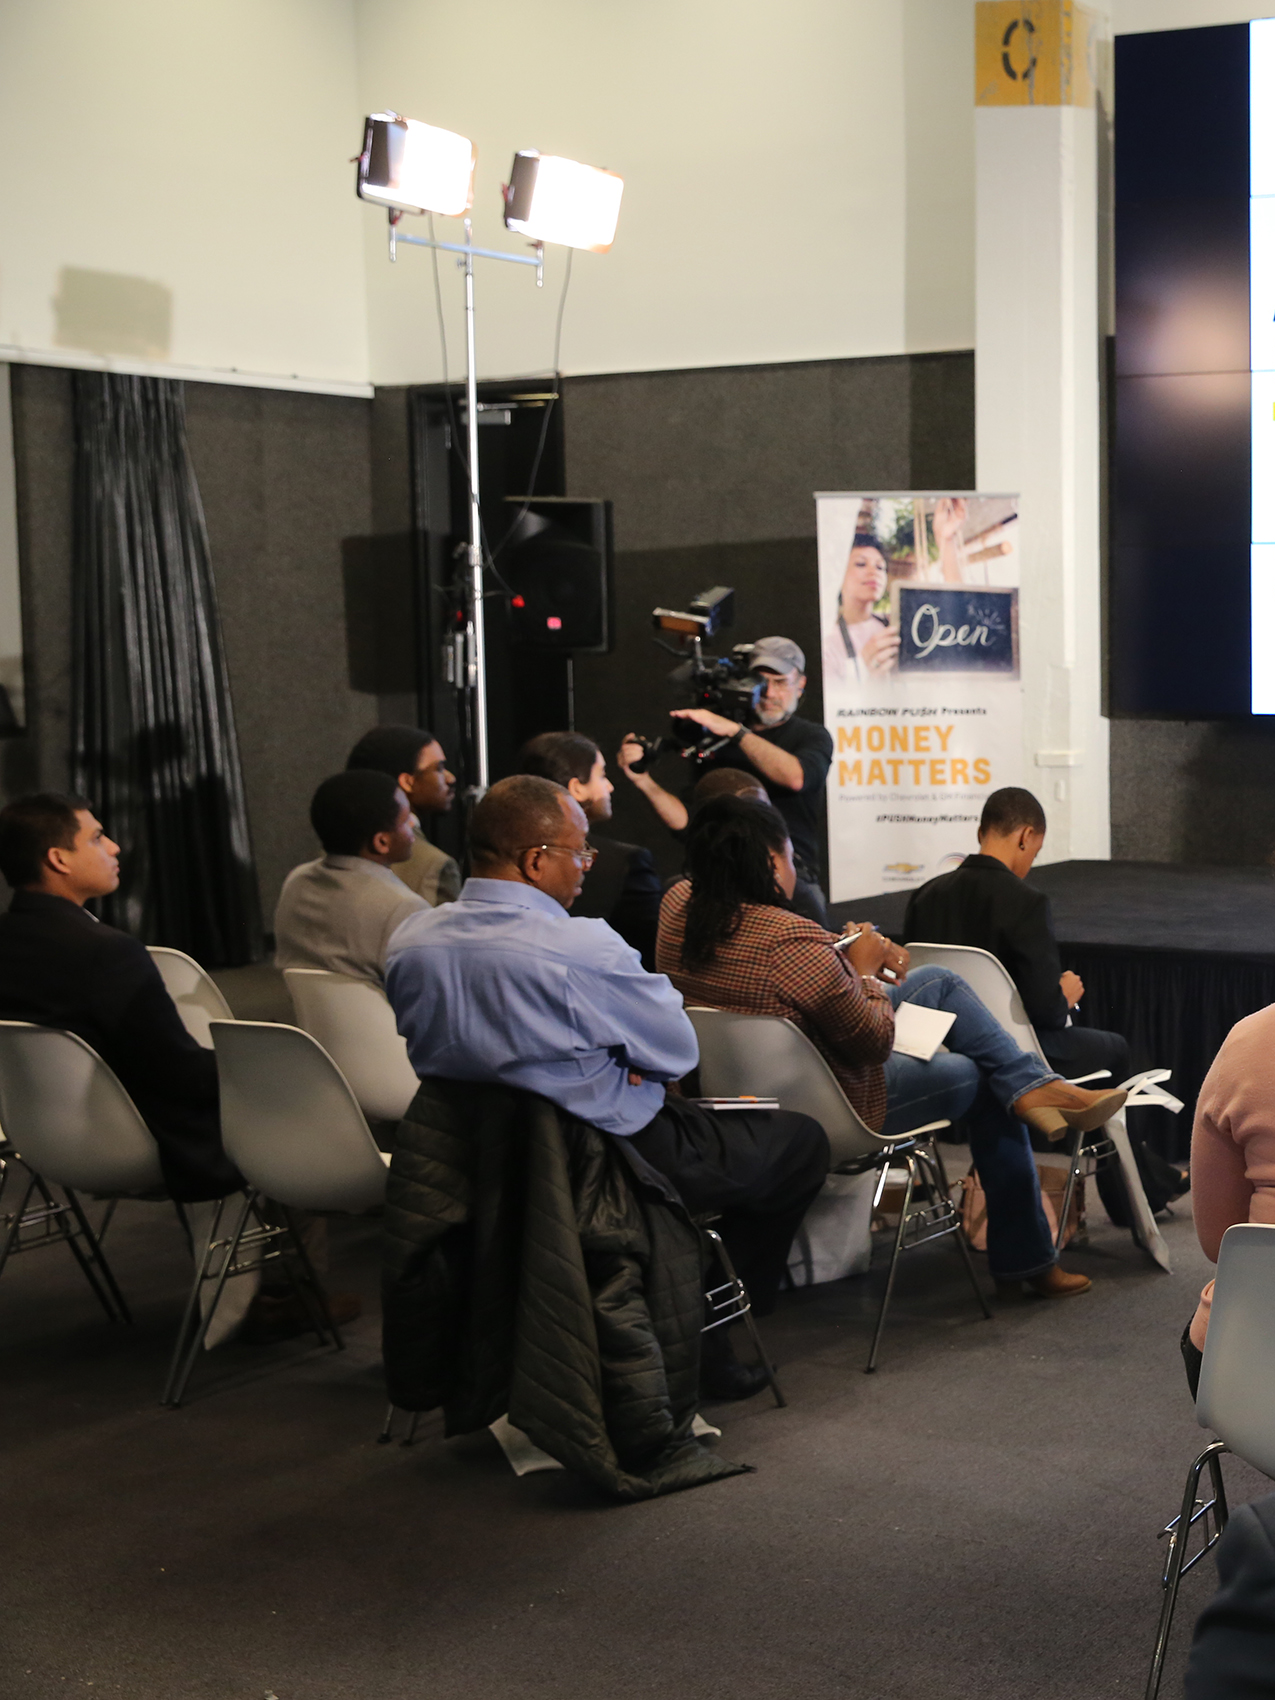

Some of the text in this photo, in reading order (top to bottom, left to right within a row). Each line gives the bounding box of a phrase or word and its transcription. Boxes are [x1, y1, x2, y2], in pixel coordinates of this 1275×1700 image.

[911, 603, 991, 659] Open
[837, 725, 955, 753] MONEY
[837, 758, 992, 786] MATTERS
